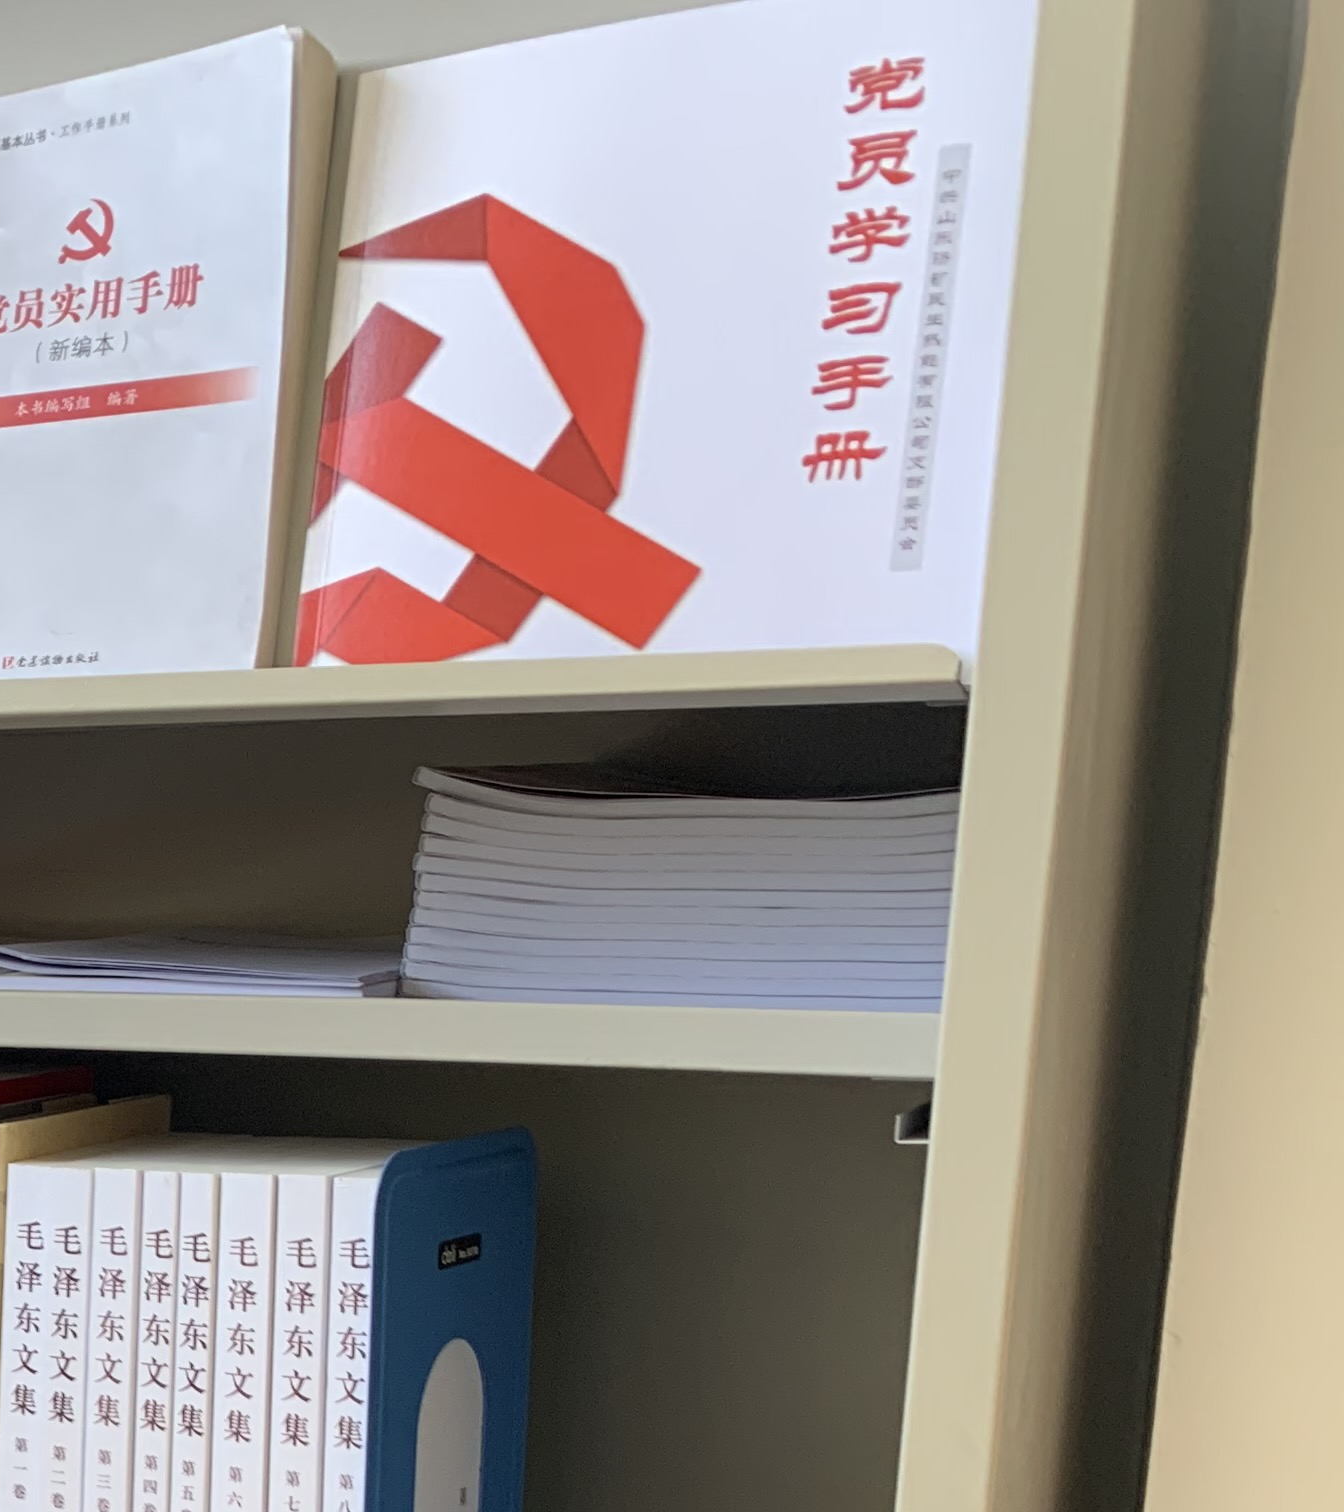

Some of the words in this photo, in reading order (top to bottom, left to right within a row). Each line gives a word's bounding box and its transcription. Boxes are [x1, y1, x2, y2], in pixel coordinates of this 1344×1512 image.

[801, 56, 926, 484] 党员学习手册
[14, 393, 91, 418] 本书编写组
[10, 1221, 44, 1416] 毛泽东文集
[48, 1225, 82, 1424] 毛泽东文集
[93, 1225, 127, 1428] 毛泽东文集
[139, 1229, 174, 1433] 毛泽东文集
[177, 1231, 211, 1438] 毛泽东文集
[223, 1236, 259, 1444] 毛泽东文集
[280, 1237, 317, 1448] 毛泽东文集
[334, 1238, 371, 1450] 毛泽东文集
[13, 1437, 28, 1501] 第一卷
[51, 1445, 67, 1510] 第二卷
